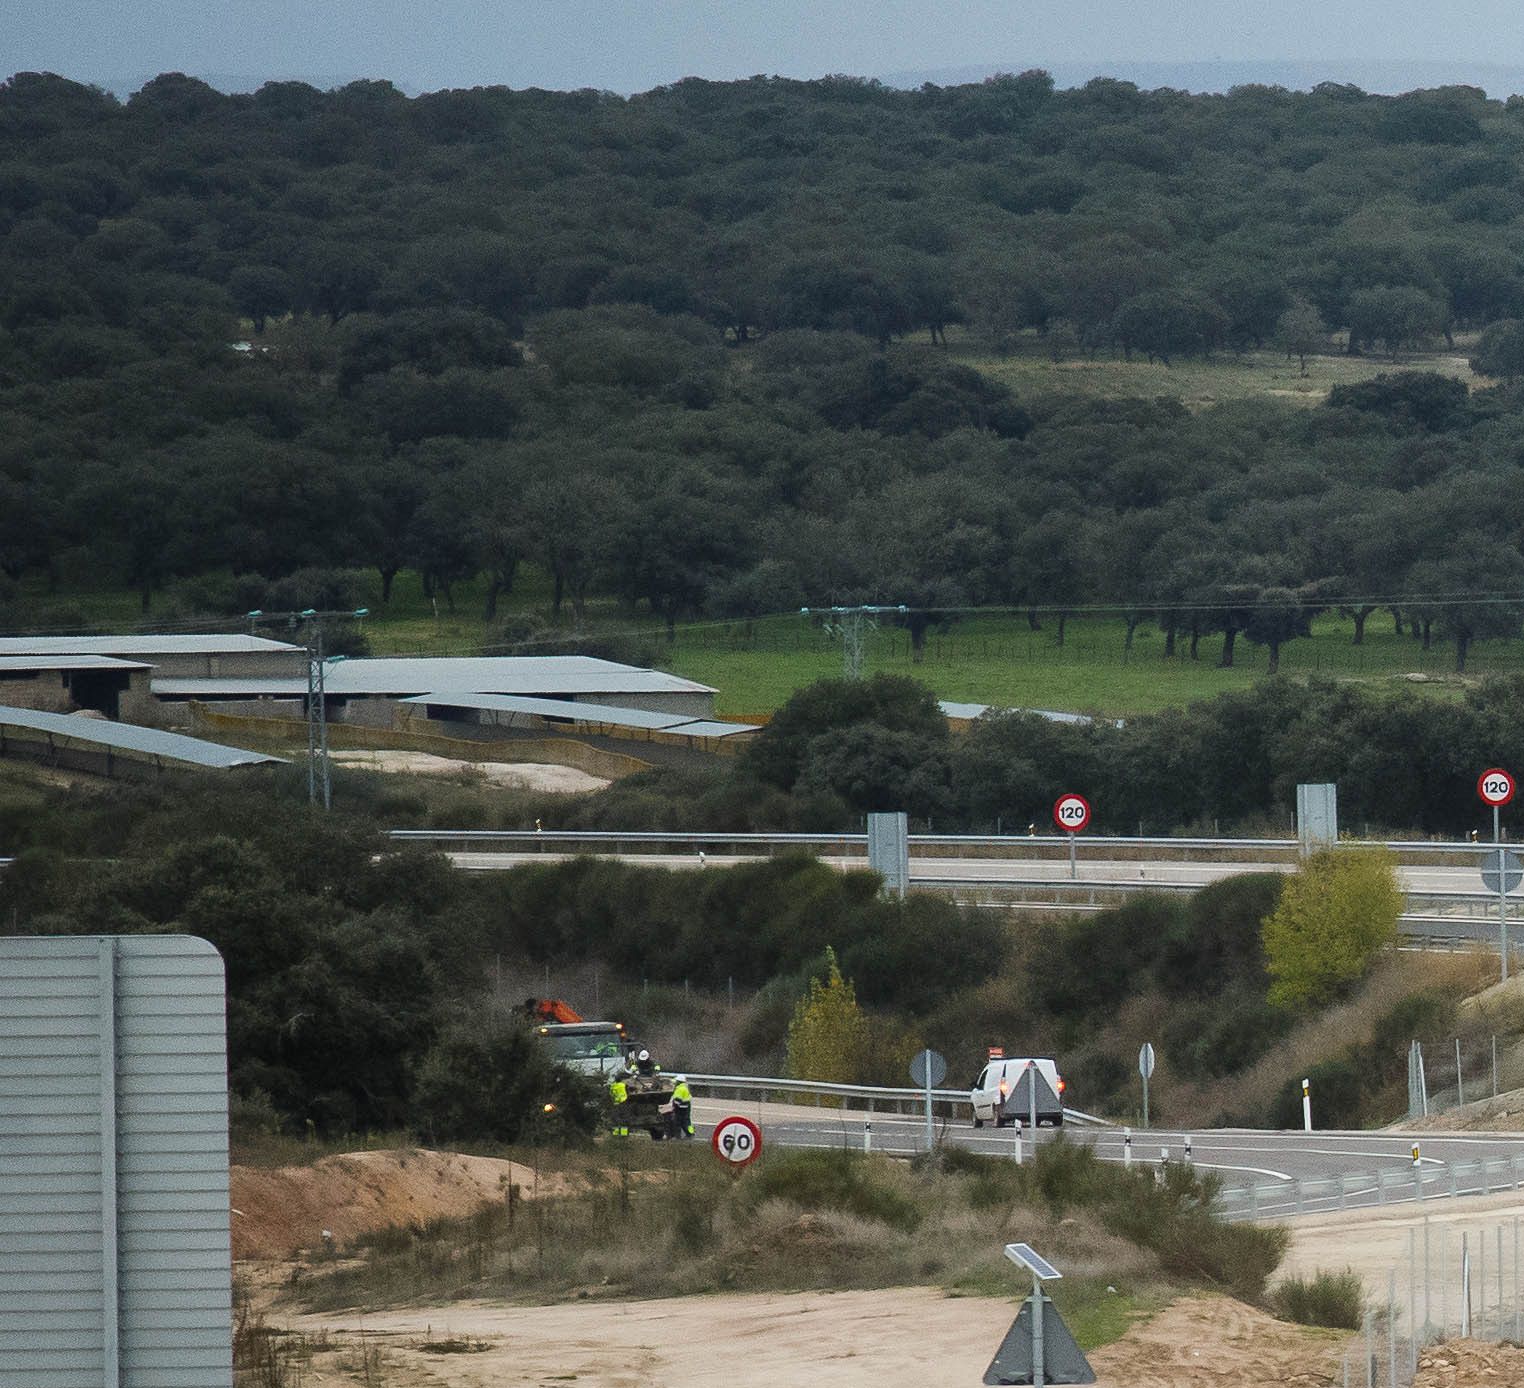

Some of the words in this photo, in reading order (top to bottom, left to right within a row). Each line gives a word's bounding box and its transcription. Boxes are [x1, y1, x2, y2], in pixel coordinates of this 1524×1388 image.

[1484, 781, 1509, 793] 120
[1060, 806, 1084, 819] 120
[723, 1134, 750, 1151] 60
